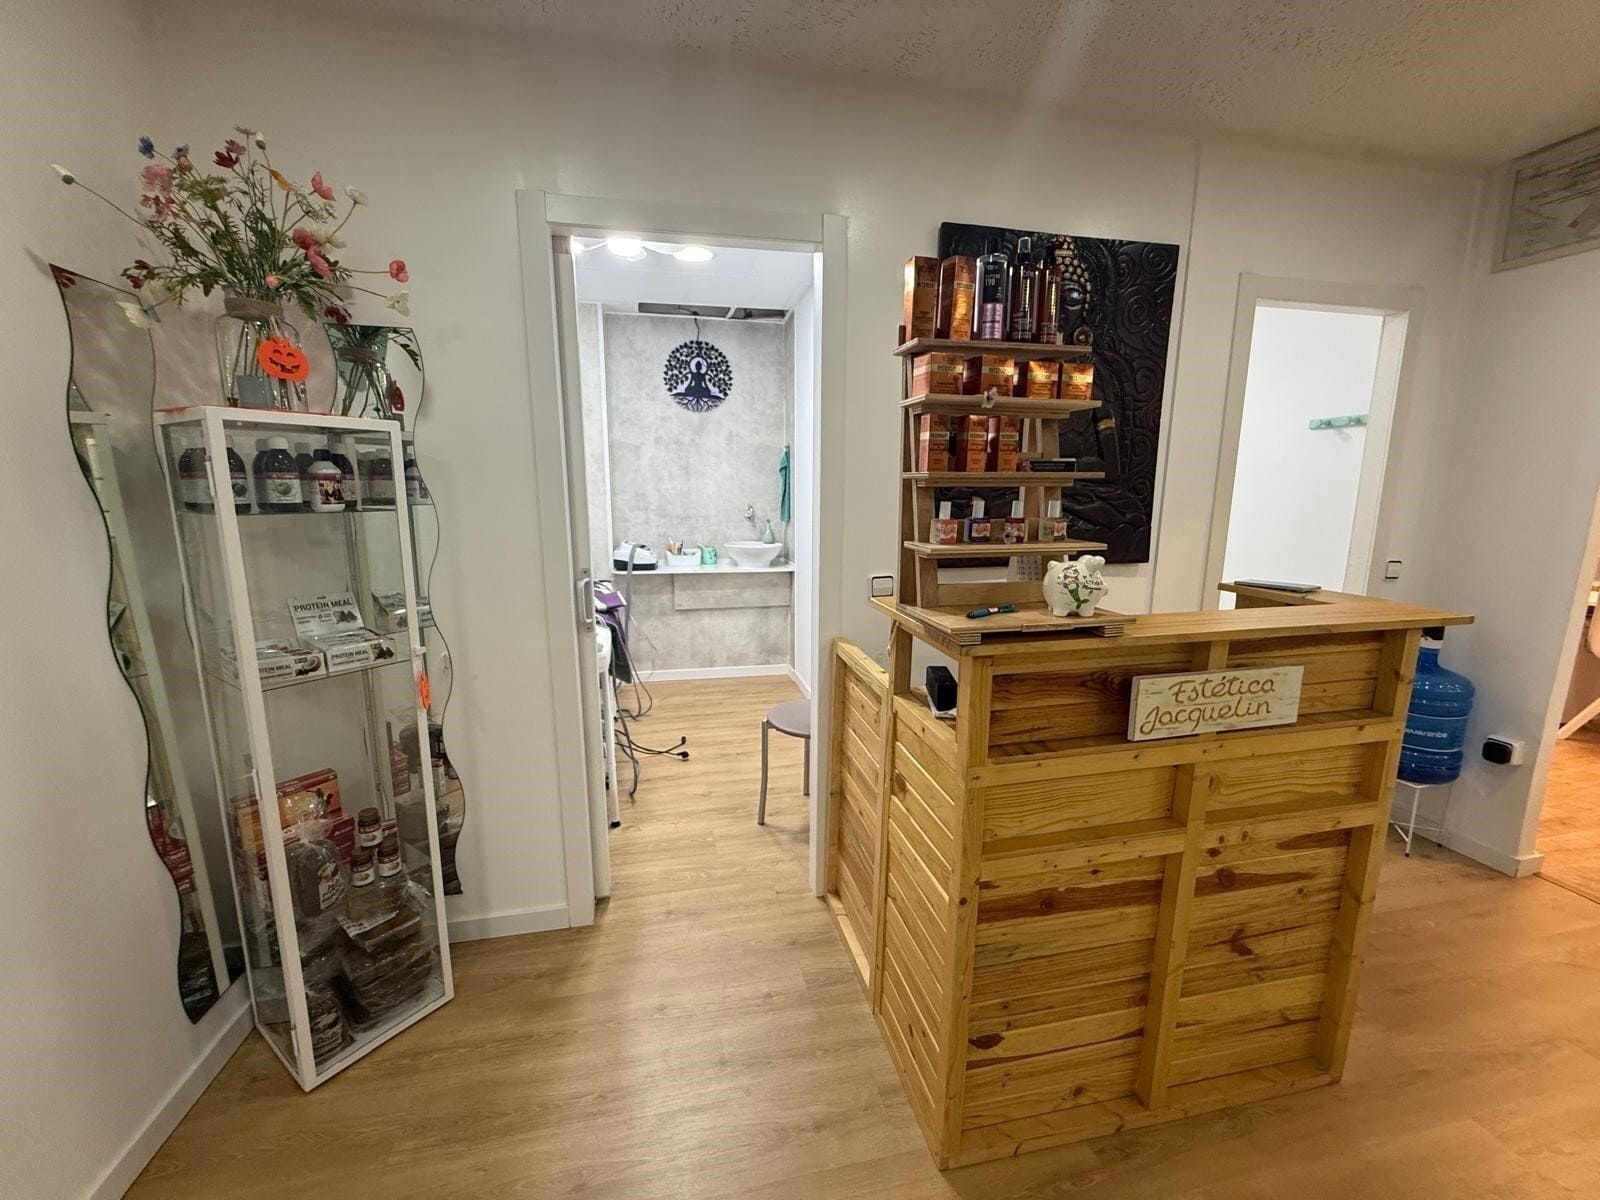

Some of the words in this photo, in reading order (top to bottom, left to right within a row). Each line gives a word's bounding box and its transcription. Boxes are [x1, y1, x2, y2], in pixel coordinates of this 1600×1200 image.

[294, 602, 330, 611] PROTEIN
[331, 598, 353, 608] MEAL
[1168, 675, 1276, 704] Estética
[1139, 696, 1272, 735] Jacquelin
